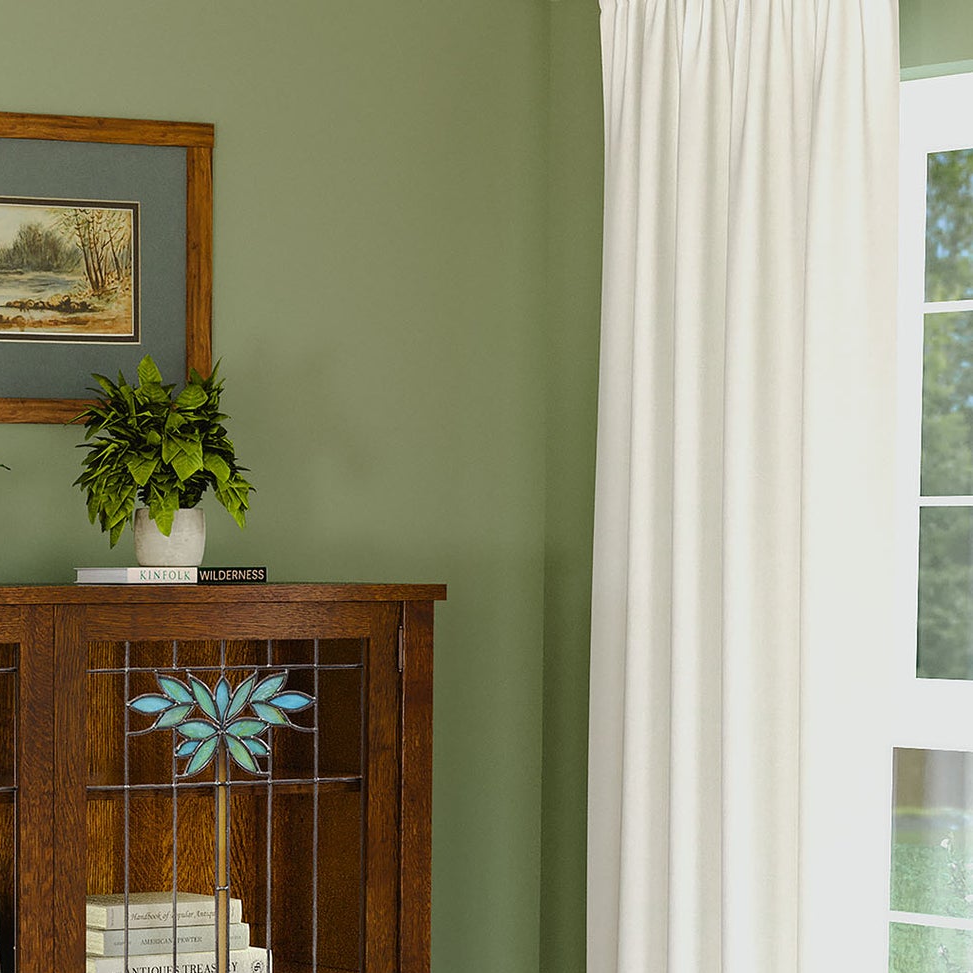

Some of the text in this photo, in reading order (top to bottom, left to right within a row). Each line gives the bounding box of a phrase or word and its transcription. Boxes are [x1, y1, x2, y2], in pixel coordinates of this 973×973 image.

[139, 569, 191, 581] KINFOLK
[199, 569, 265, 581] WILDERNESS
[140, 936, 173, 946] AMERICAN
